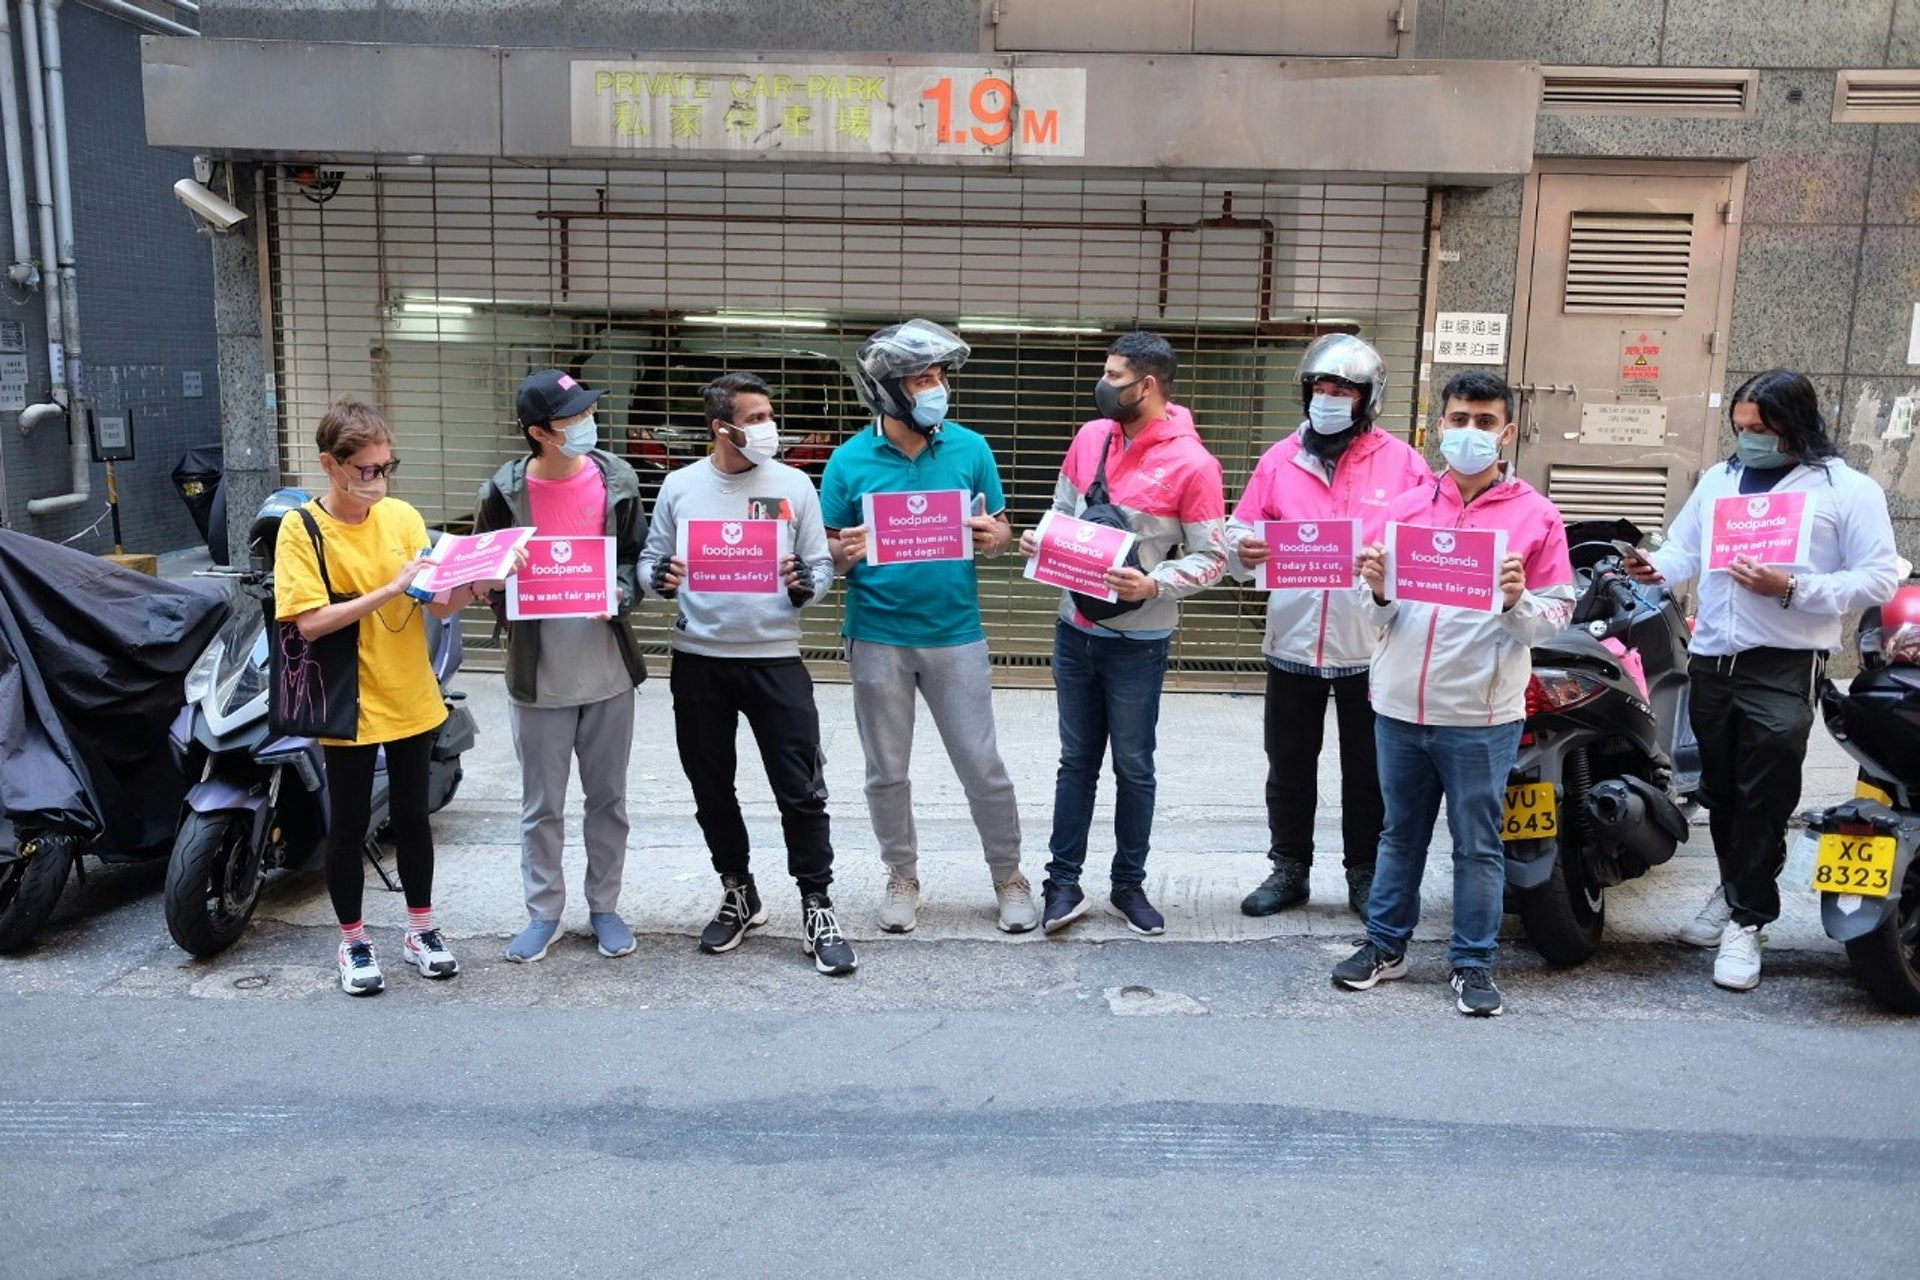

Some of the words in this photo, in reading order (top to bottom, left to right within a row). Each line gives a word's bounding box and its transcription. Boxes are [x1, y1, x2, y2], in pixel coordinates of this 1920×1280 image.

[594, 71, 712, 98] PRIVATE
[729, 73, 887, 100] CAR-PARK
[612, 101, 872, 141] 私家停車場
[1438, 341, 1500, 357] 嚴禁泊車
[888, 514, 948, 527] foodpanda
[1726, 515, 1787, 531] foodpanda
[881, 537, 897, 546] We
[898, 537, 914, 545] are
[916, 535, 958, 544] humans,
[1054, 537, 1104, 559] foodpanda
[1715, 544, 1730, 553] We
[1732, 543, 1748, 552] are
[1750, 540, 1766, 550] not
[1767, 538, 1793, 549] your
[702, 544, 763, 558] foodpanda
[896, 549, 912, 557] not
[914, 547, 945, 557] dogs!!
[1279, 543, 1339, 554] foodpanda
[1275, 562, 1307, 572] Today
[1308, 561, 1321, 571] $1
[1322, 562, 1343, 571] cut,
[1411, 550, 1478, 568] foodpanda
[531, 563, 593, 577] foodpanda
[692, 571, 717, 580] Give
[719, 573, 731, 581] us
[734, 571, 774, 582] Safety!
[1277, 575, 1327, 584] tomorrow
[1329, 574, 1342, 584] $1
[1397, 578, 1414, 588] We
[1416, 580, 1443, 590] want
[1445, 581, 1465, 593] fair
[1467, 586, 1492, 598] pay!
[519, 592, 535, 602] We
[537, 592, 563, 601] want
[565, 591, 583, 601] fair
[585, 591, 606, 602] pay!
[1505, 789, 1536, 811] VU
[1499, 811, 1555, 834] 643
[1838, 841, 1873, 862] XG
[1816, 865, 1888, 888] 8323
